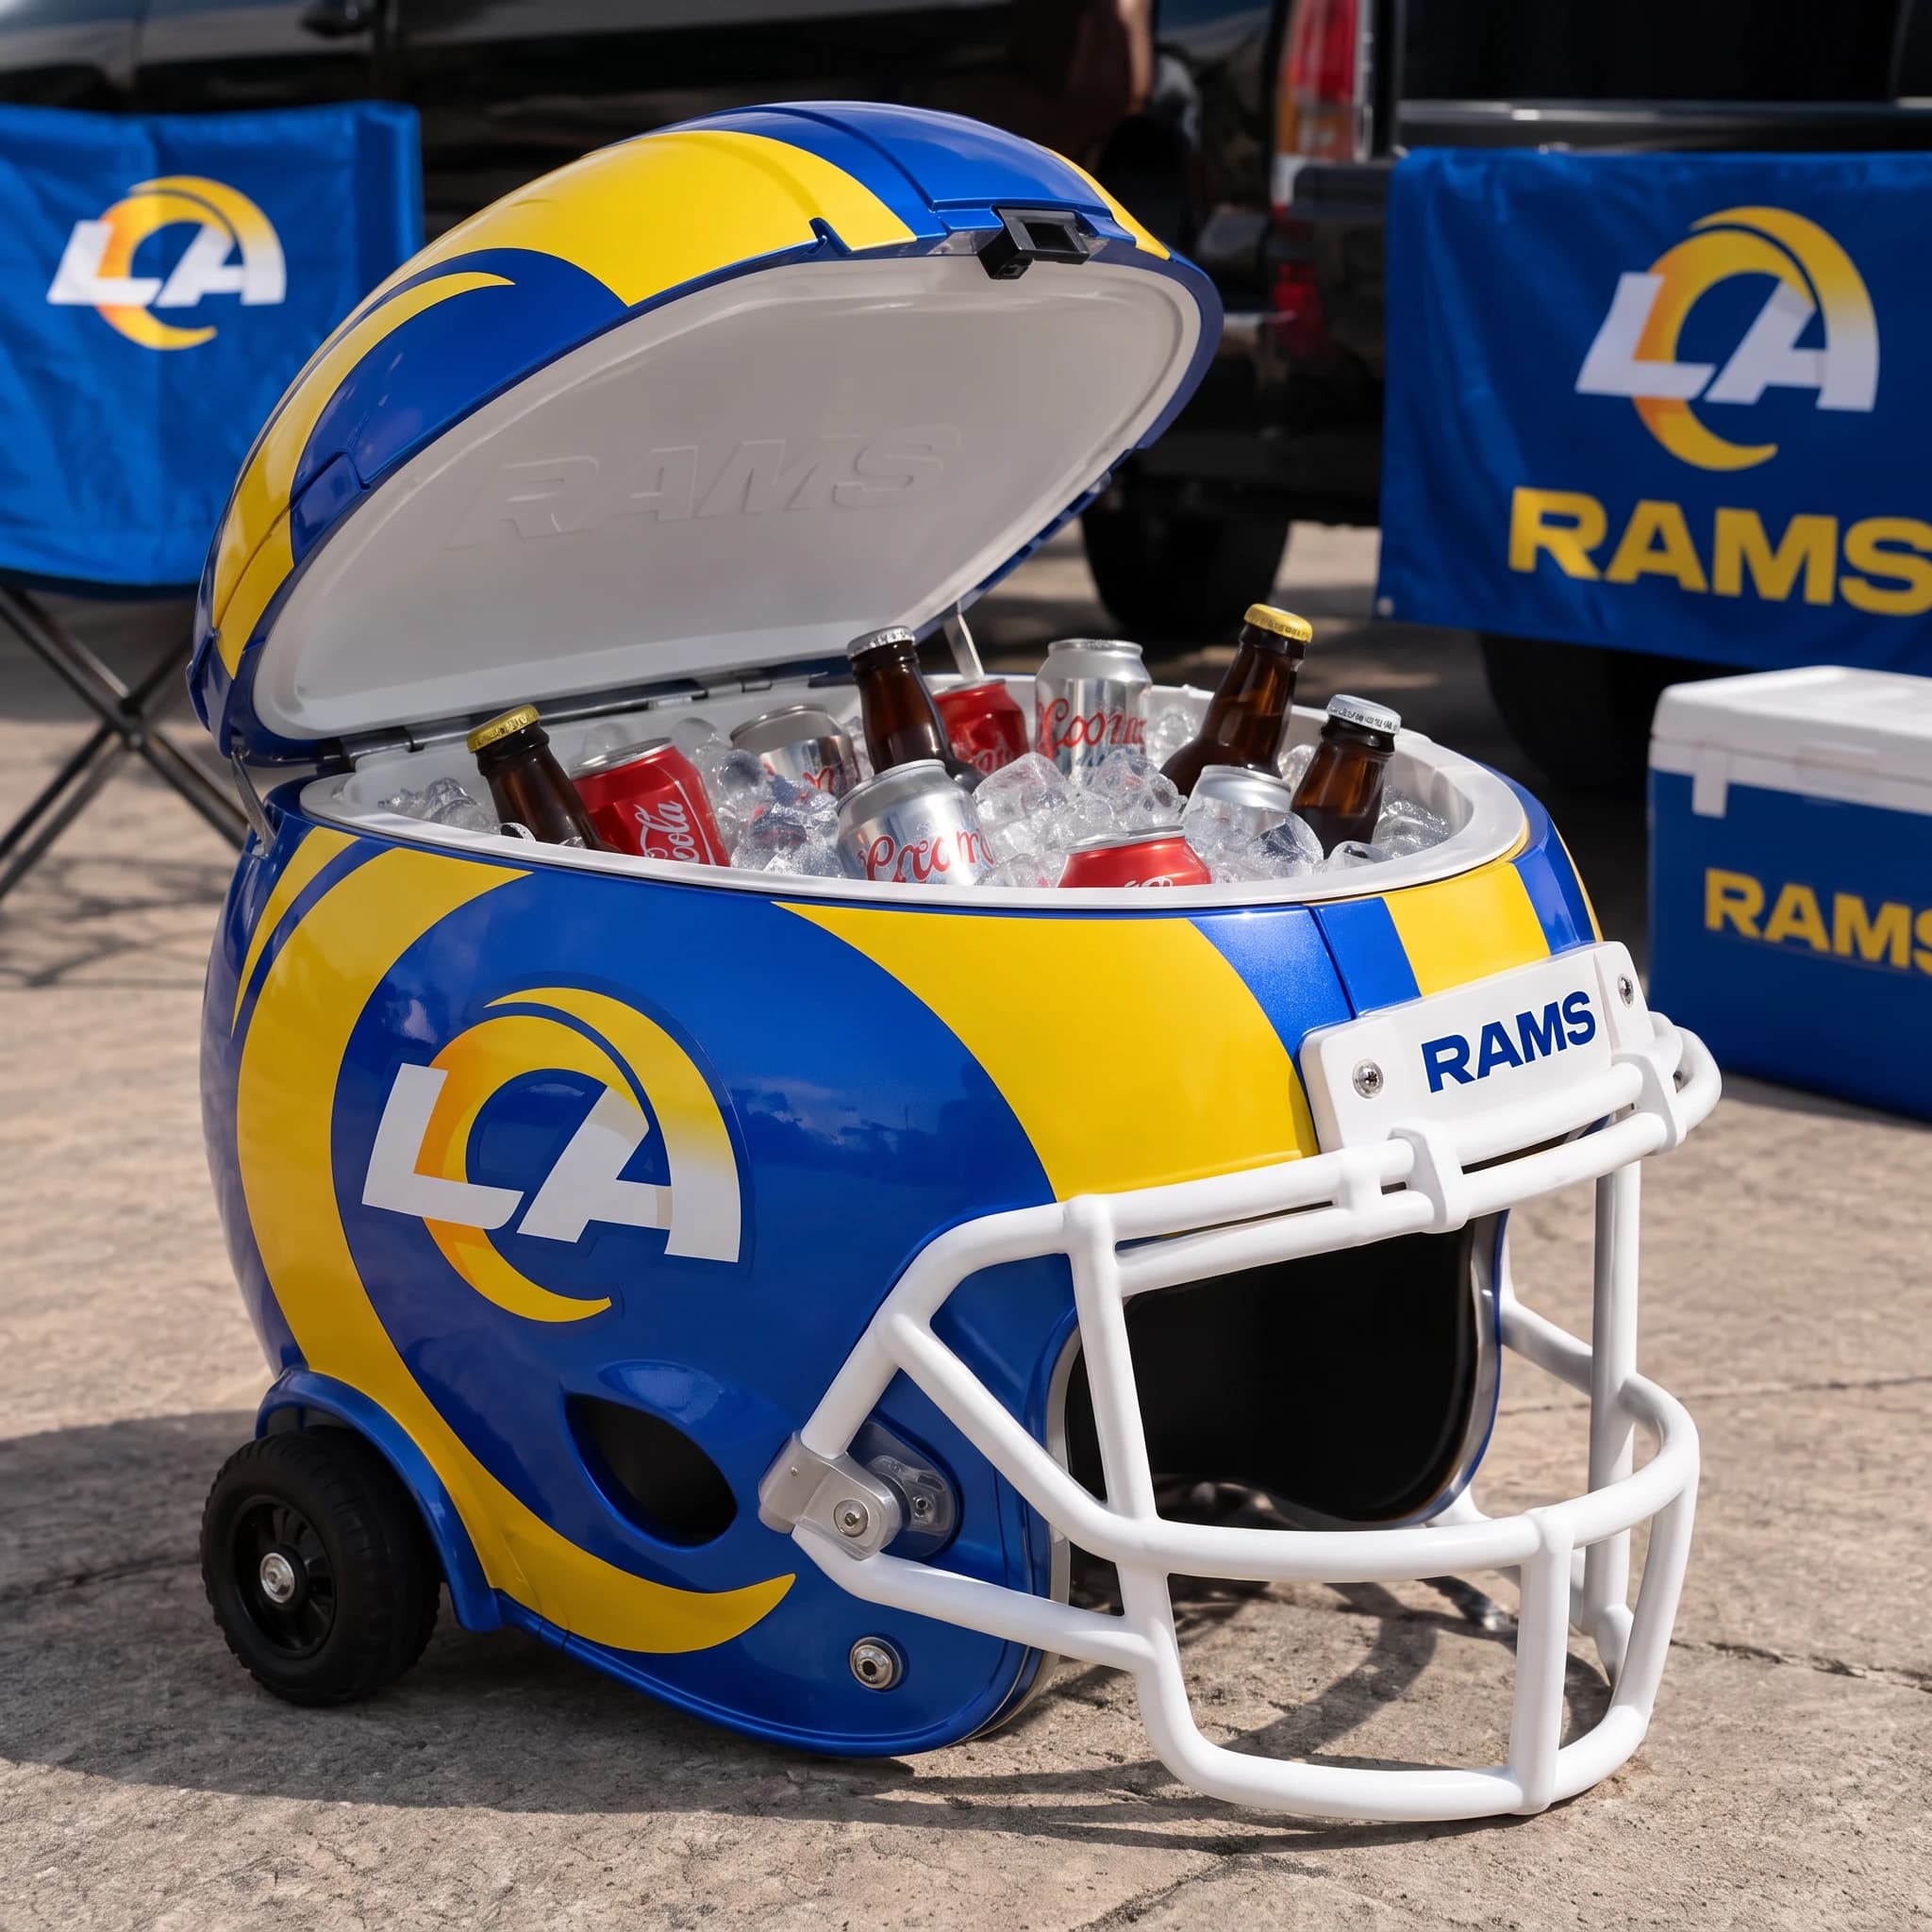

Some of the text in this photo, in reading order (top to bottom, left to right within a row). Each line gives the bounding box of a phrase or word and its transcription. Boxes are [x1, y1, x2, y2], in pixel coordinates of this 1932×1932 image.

[47, 175, 287, 308] LA
[1575, 206, 1879, 412] LA
[443, 425, 961, 550] RAMS
[1508, 486, 1932, 616] RAMS
[1421, 991, 1596, 1093] RAMS
[362, 987, 742, 1263] LA
